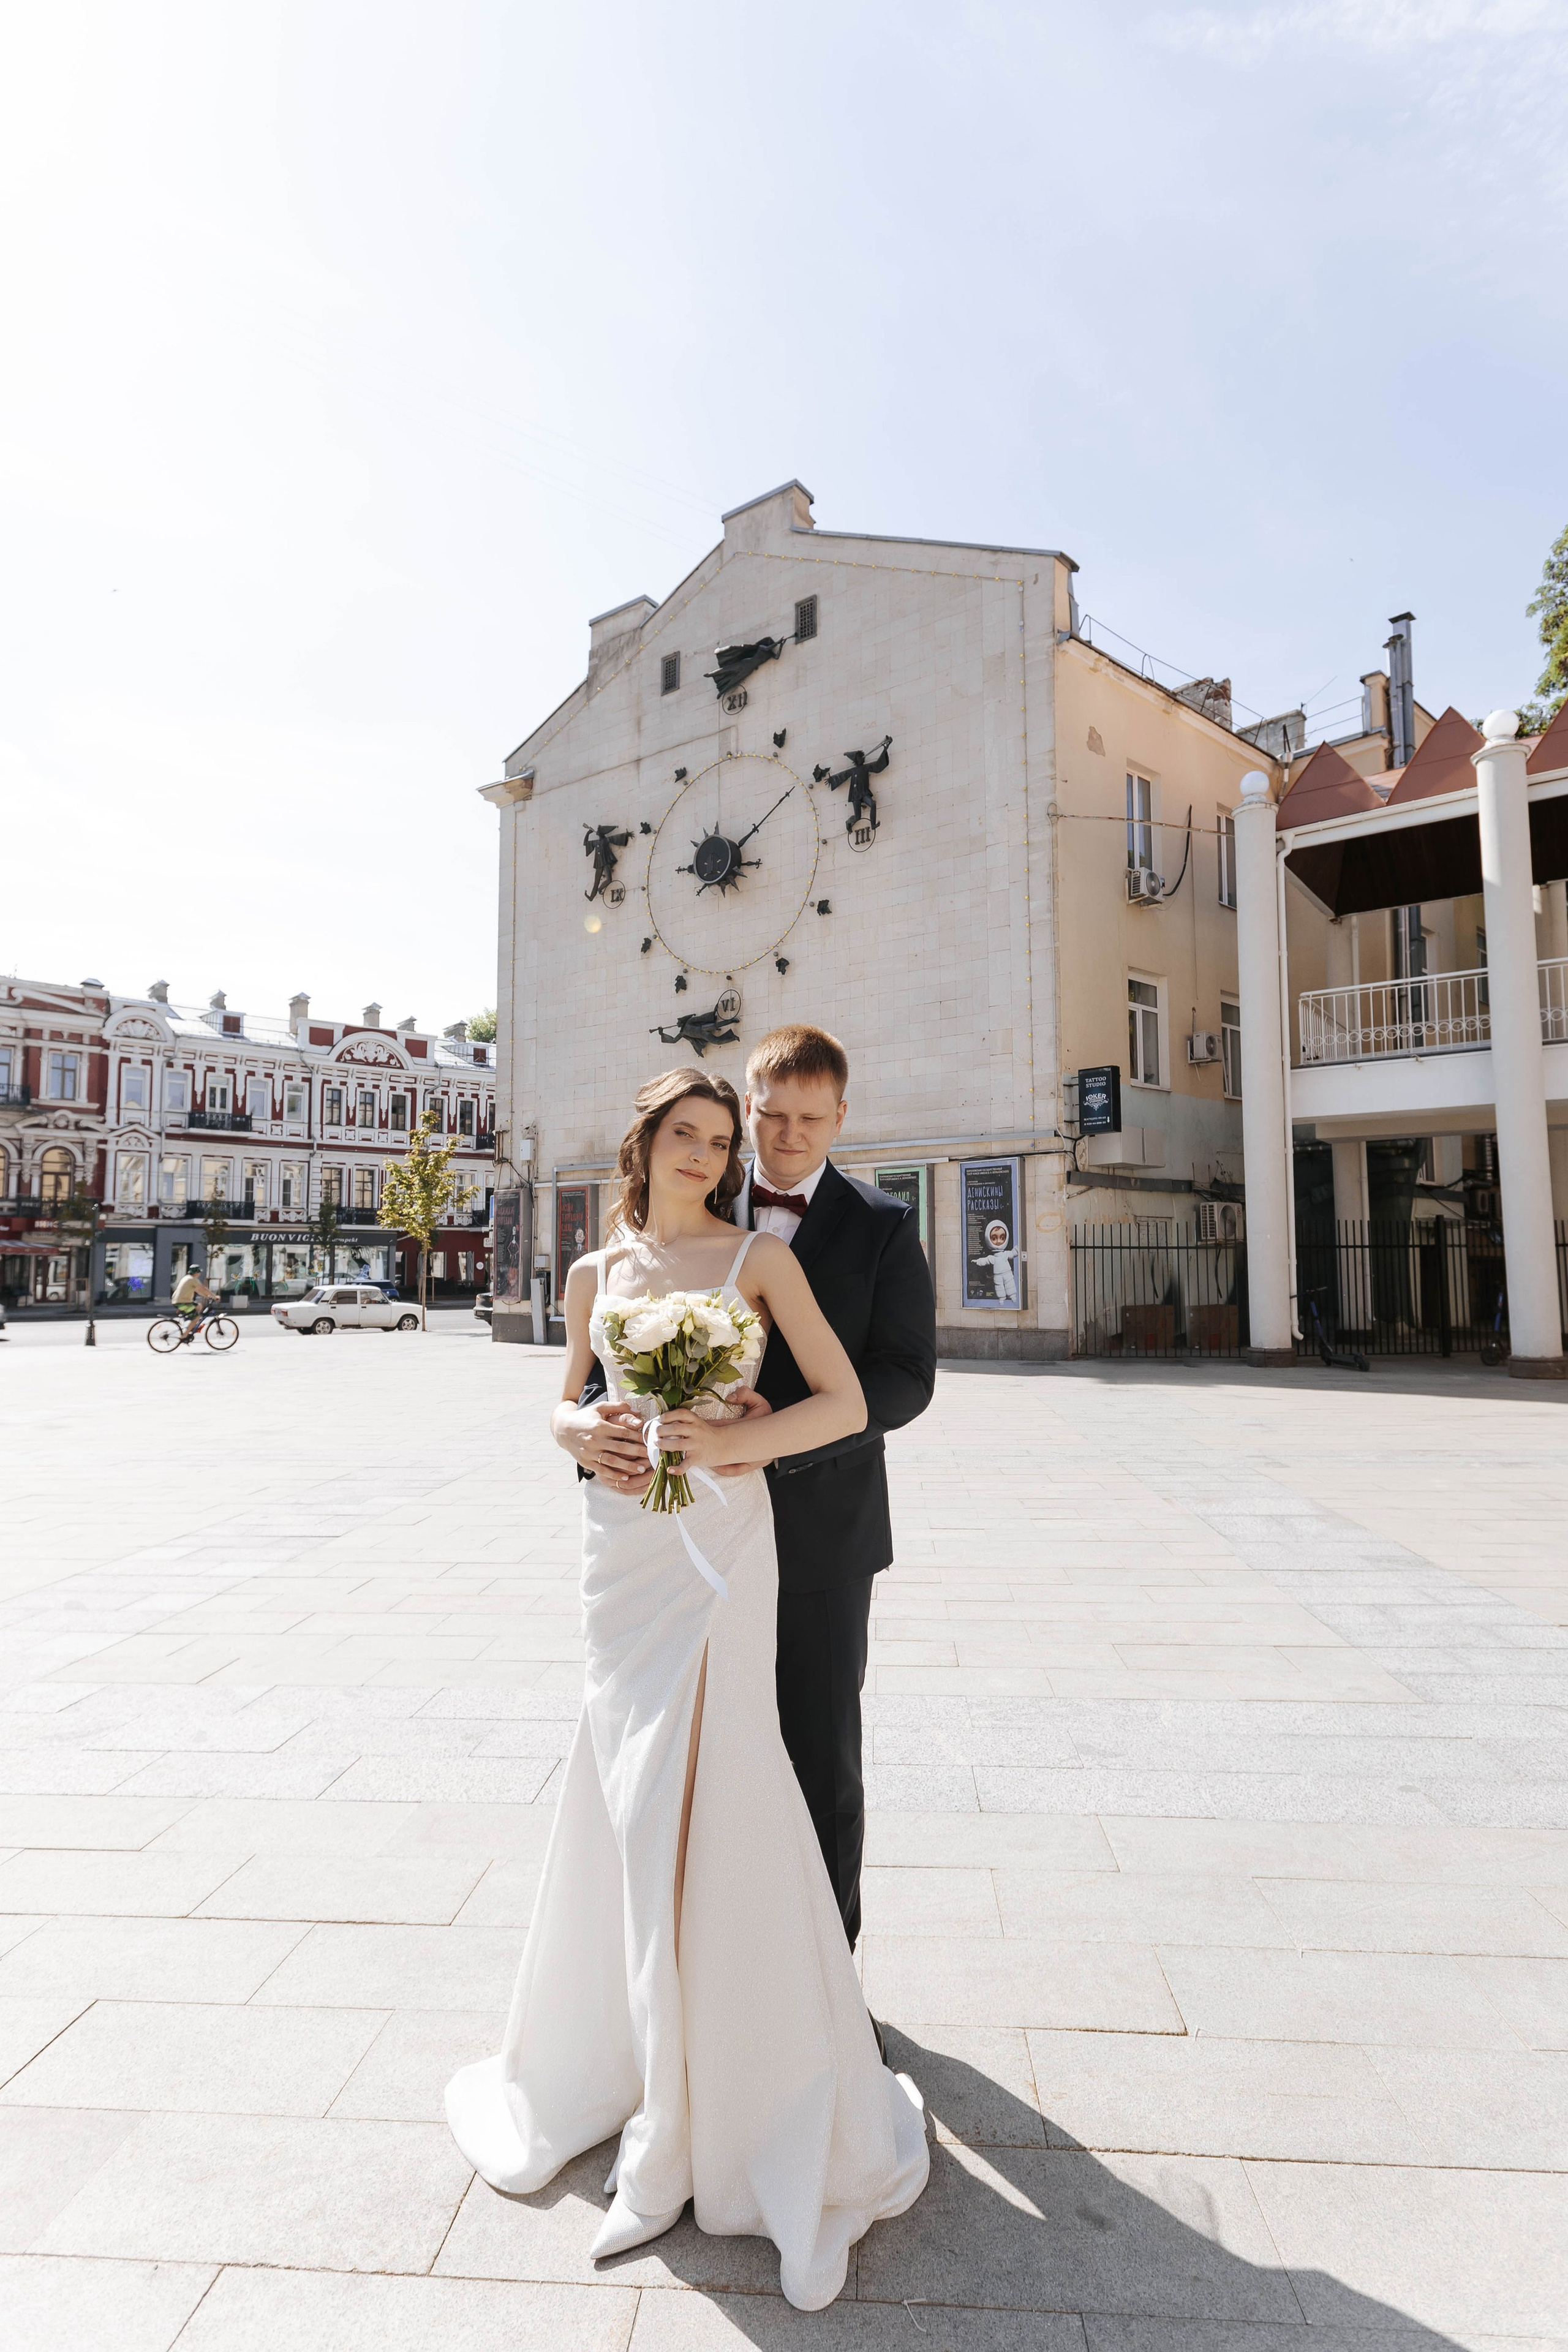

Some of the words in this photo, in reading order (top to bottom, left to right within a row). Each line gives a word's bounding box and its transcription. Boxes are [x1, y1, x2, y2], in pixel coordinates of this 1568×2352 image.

[727, 692, 747, 710] XII
[855, 827, 870, 845] III
[611, 888, 624, 902] IX
[720, 997, 736, 1012] VI
[967, 1185, 1003, 1198] ДЕНИСКИНЫ
[968, 1199, 999, 1211] РАССКАЗЫ
